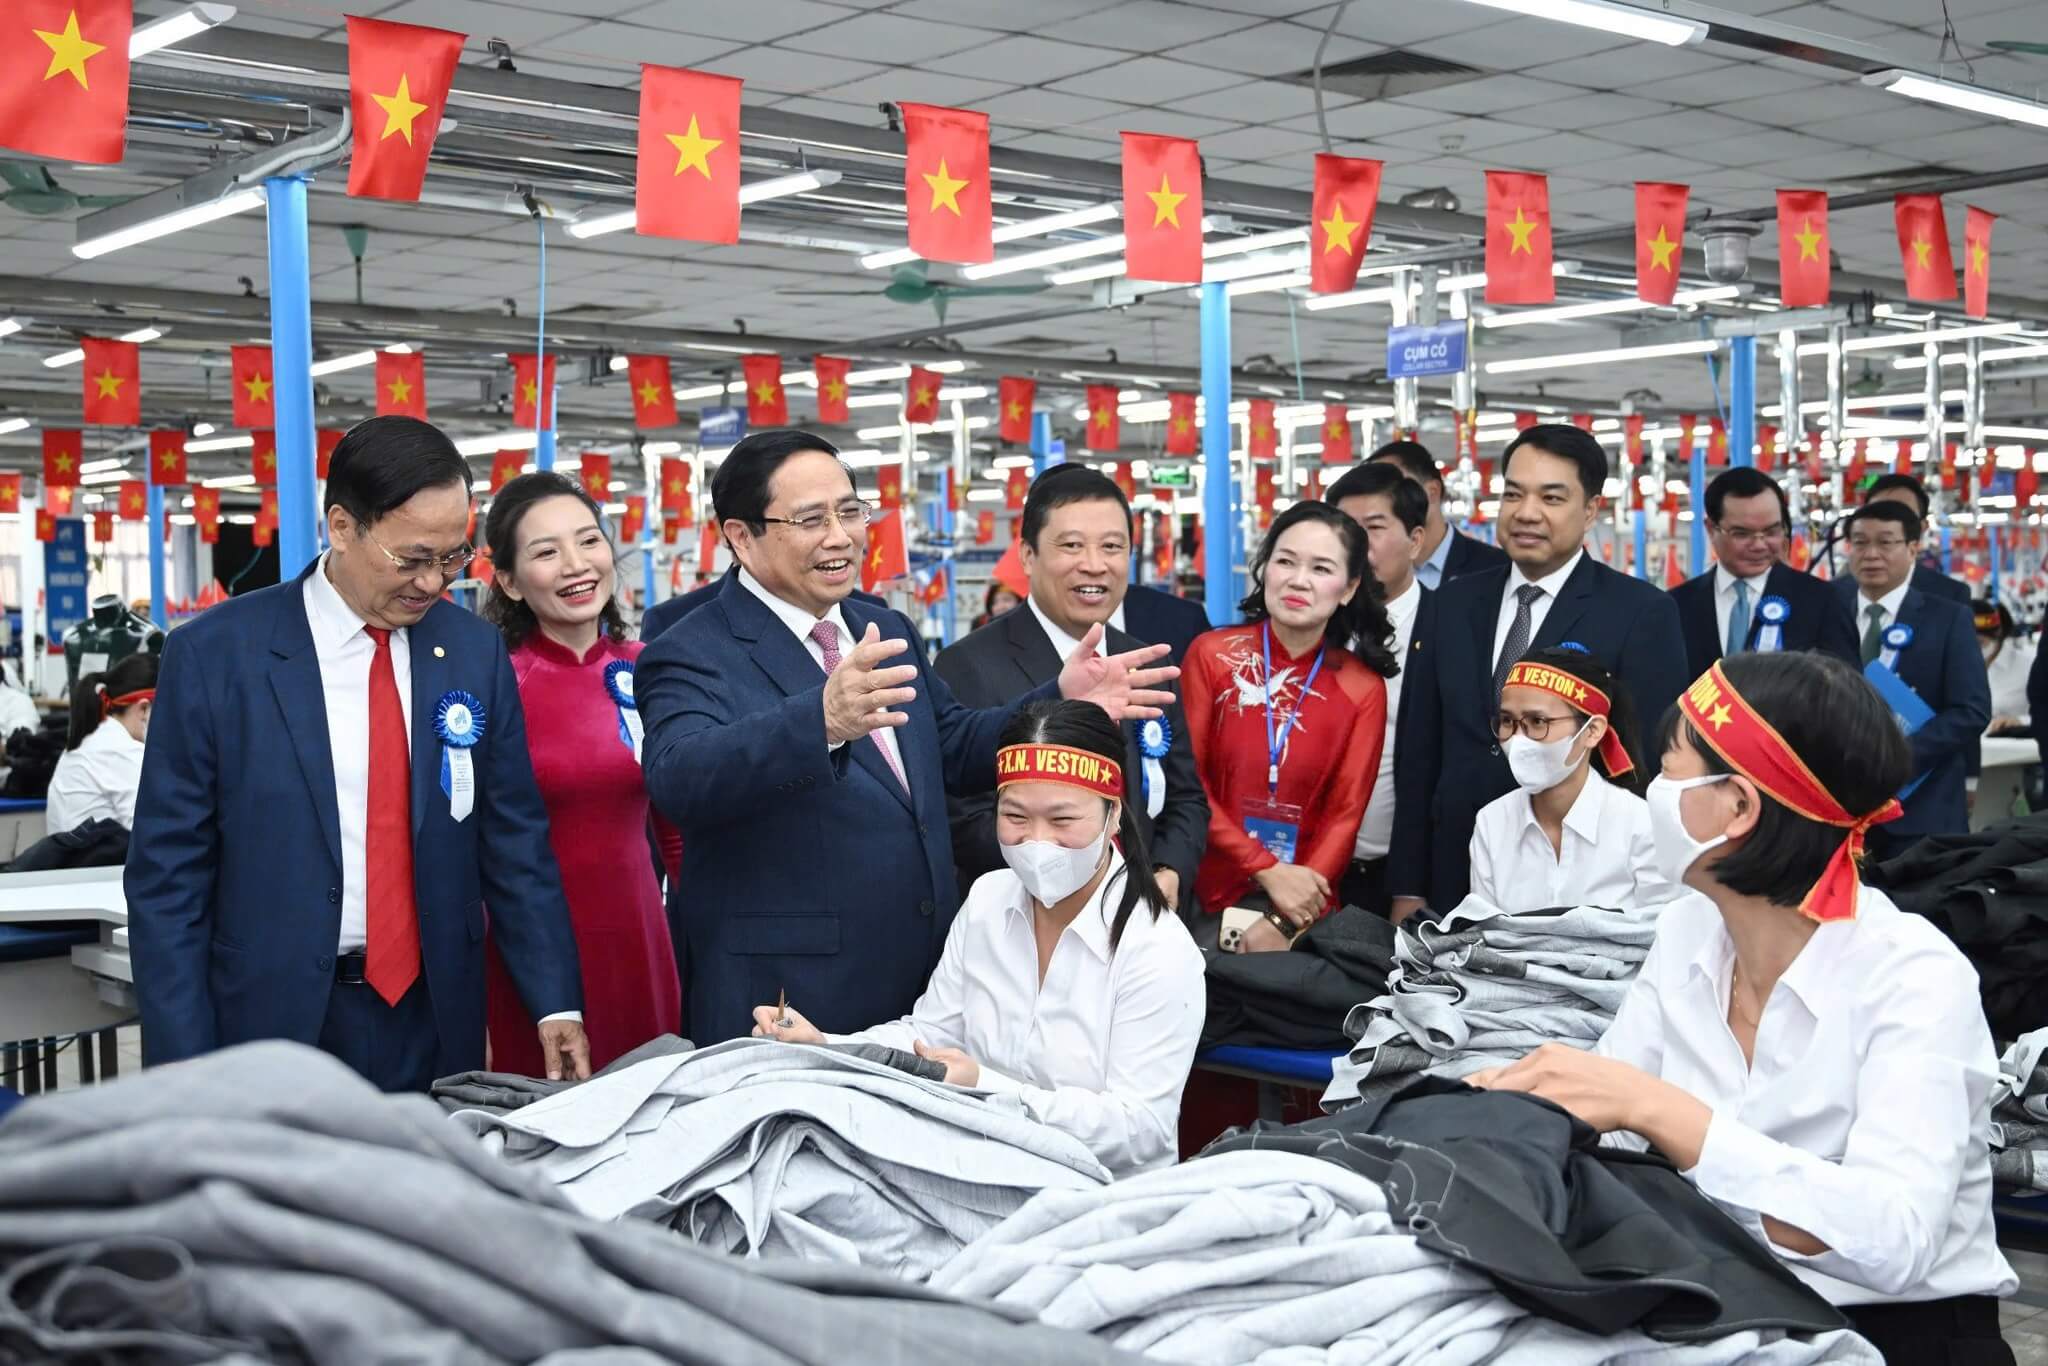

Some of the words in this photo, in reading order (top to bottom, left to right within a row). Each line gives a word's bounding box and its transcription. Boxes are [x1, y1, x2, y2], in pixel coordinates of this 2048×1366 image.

[1523, 666, 1576, 697] VESTON
[1004, 749, 1030, 774] X.N.
[1036, 749, 1099, 782] VESTON
